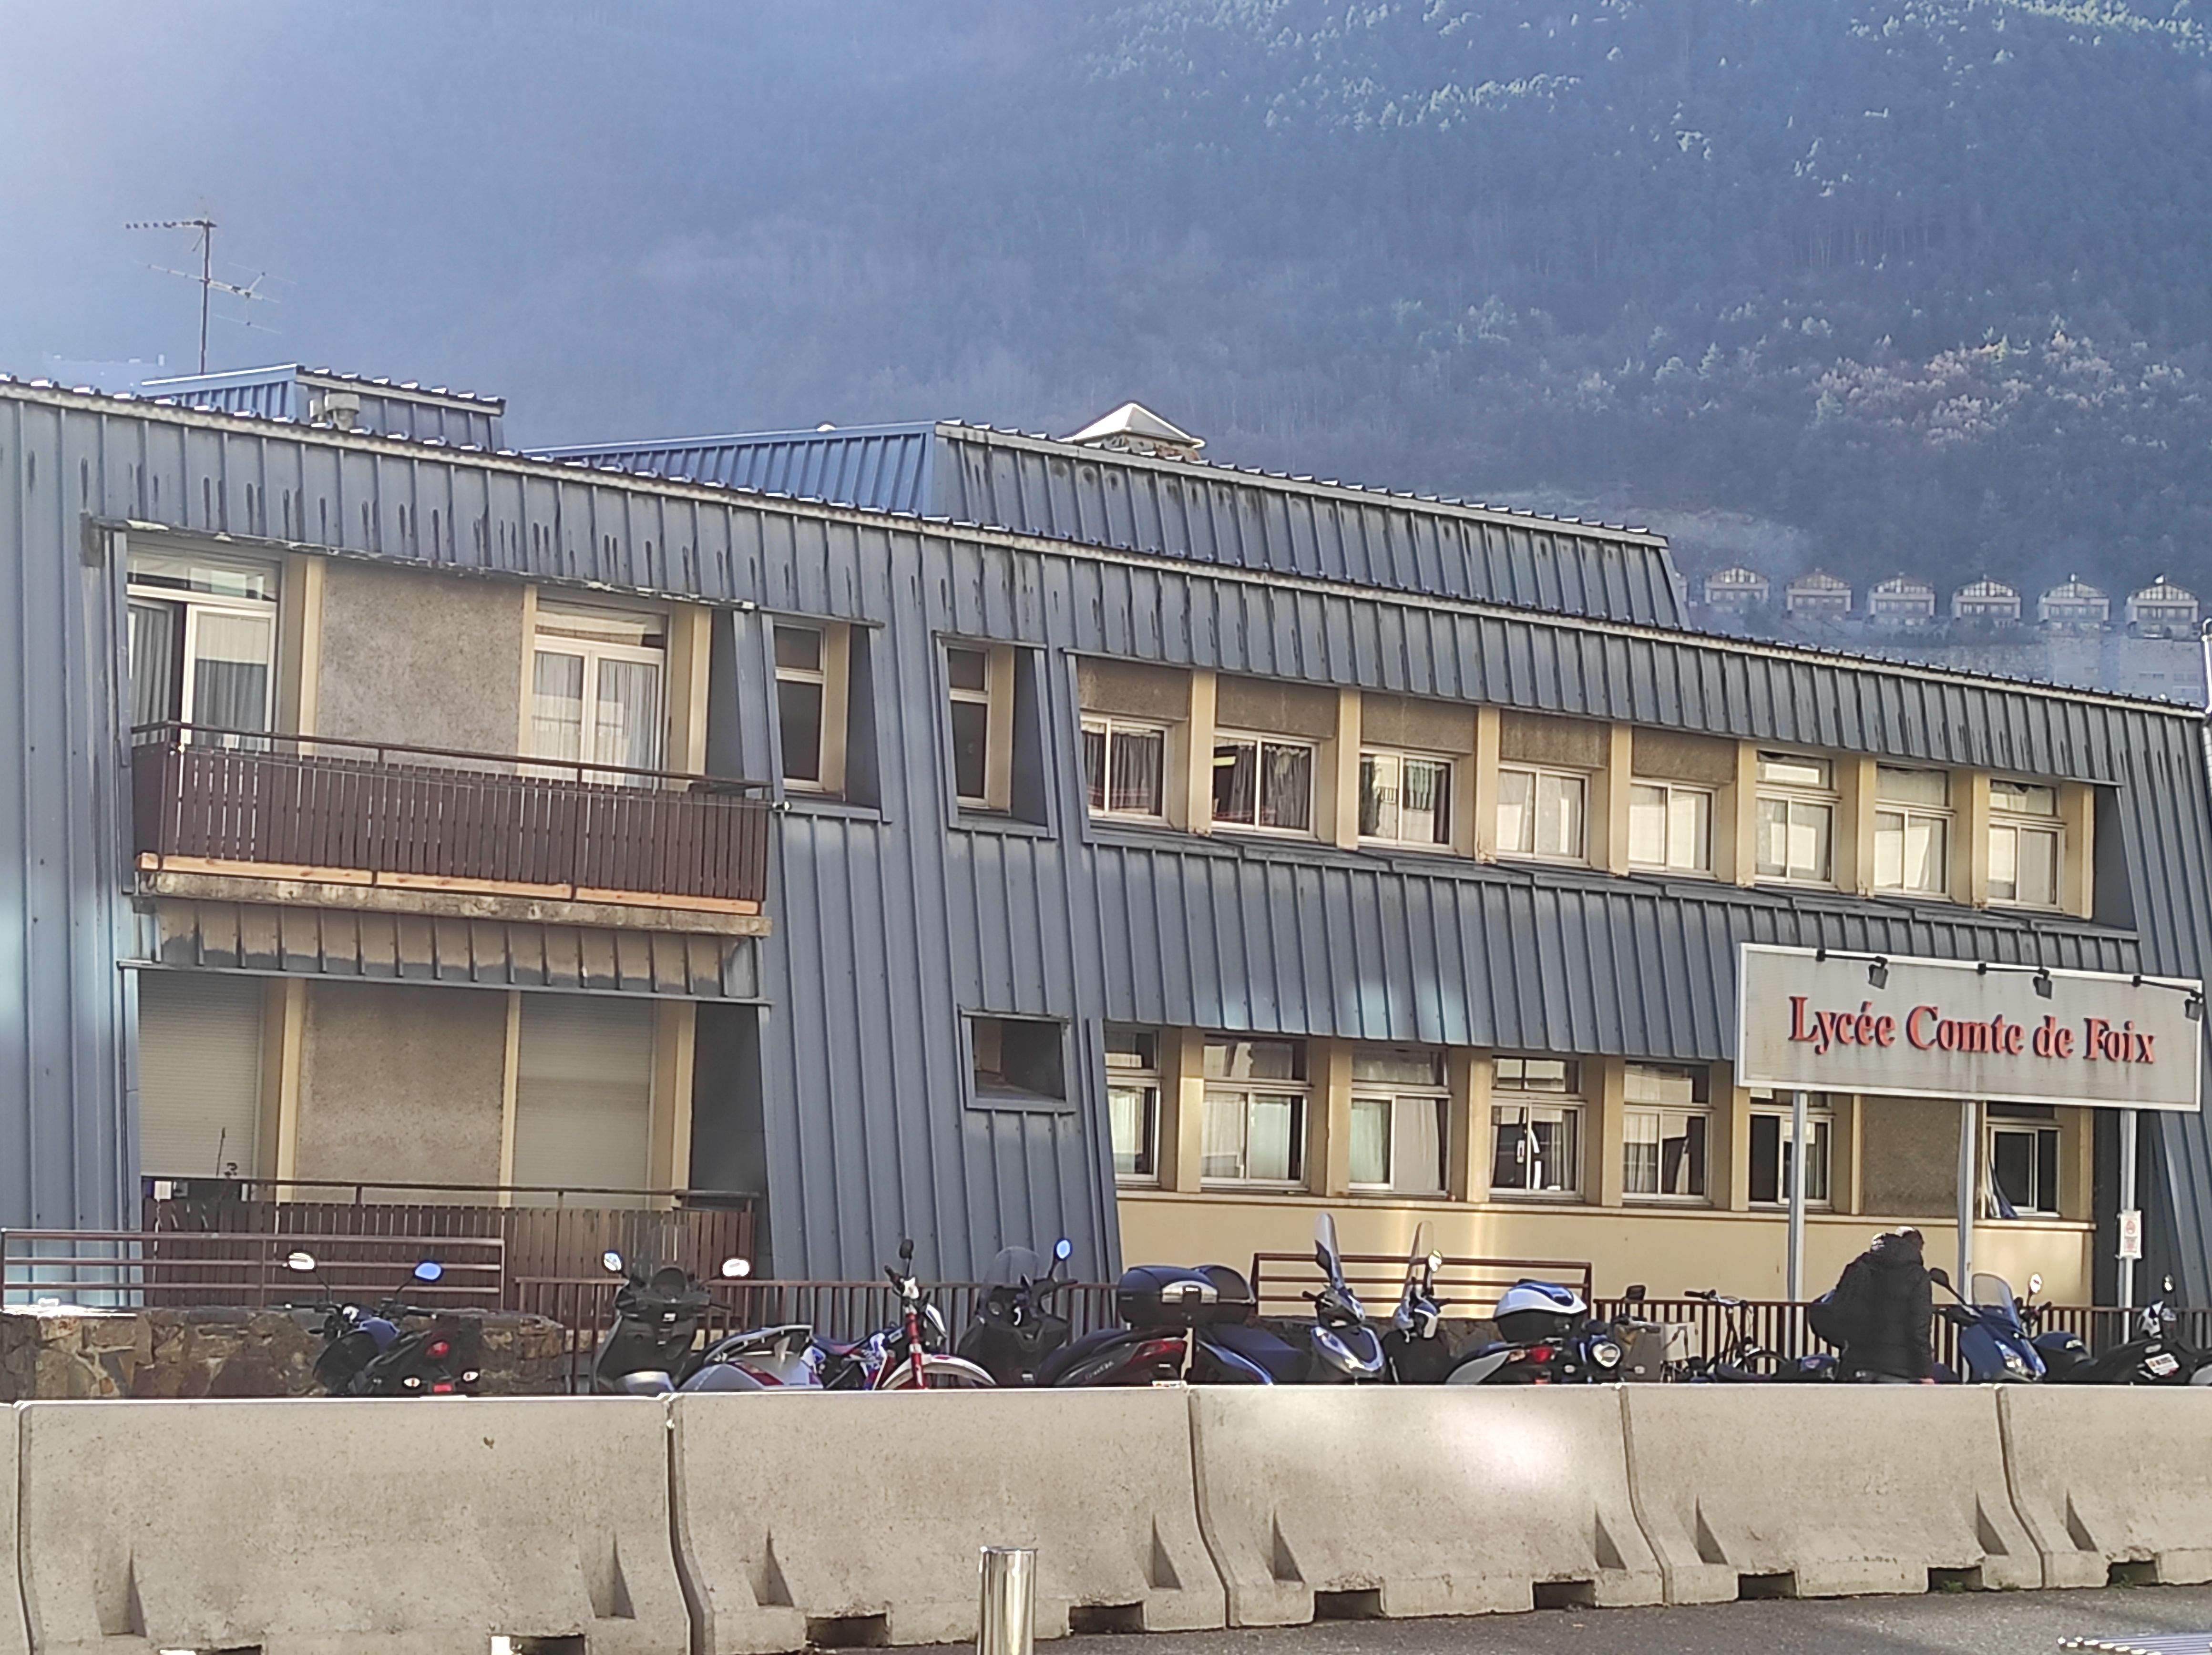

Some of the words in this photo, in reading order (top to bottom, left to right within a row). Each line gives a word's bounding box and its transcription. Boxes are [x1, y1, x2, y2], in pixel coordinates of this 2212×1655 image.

[1788, 996, 1896, 1055] Lycée
[1906, 1006, 2024, 1055] Comte
[2033, 1015, 2074, 1058] de
[2083, 1018, 2156, 1064] Foix
